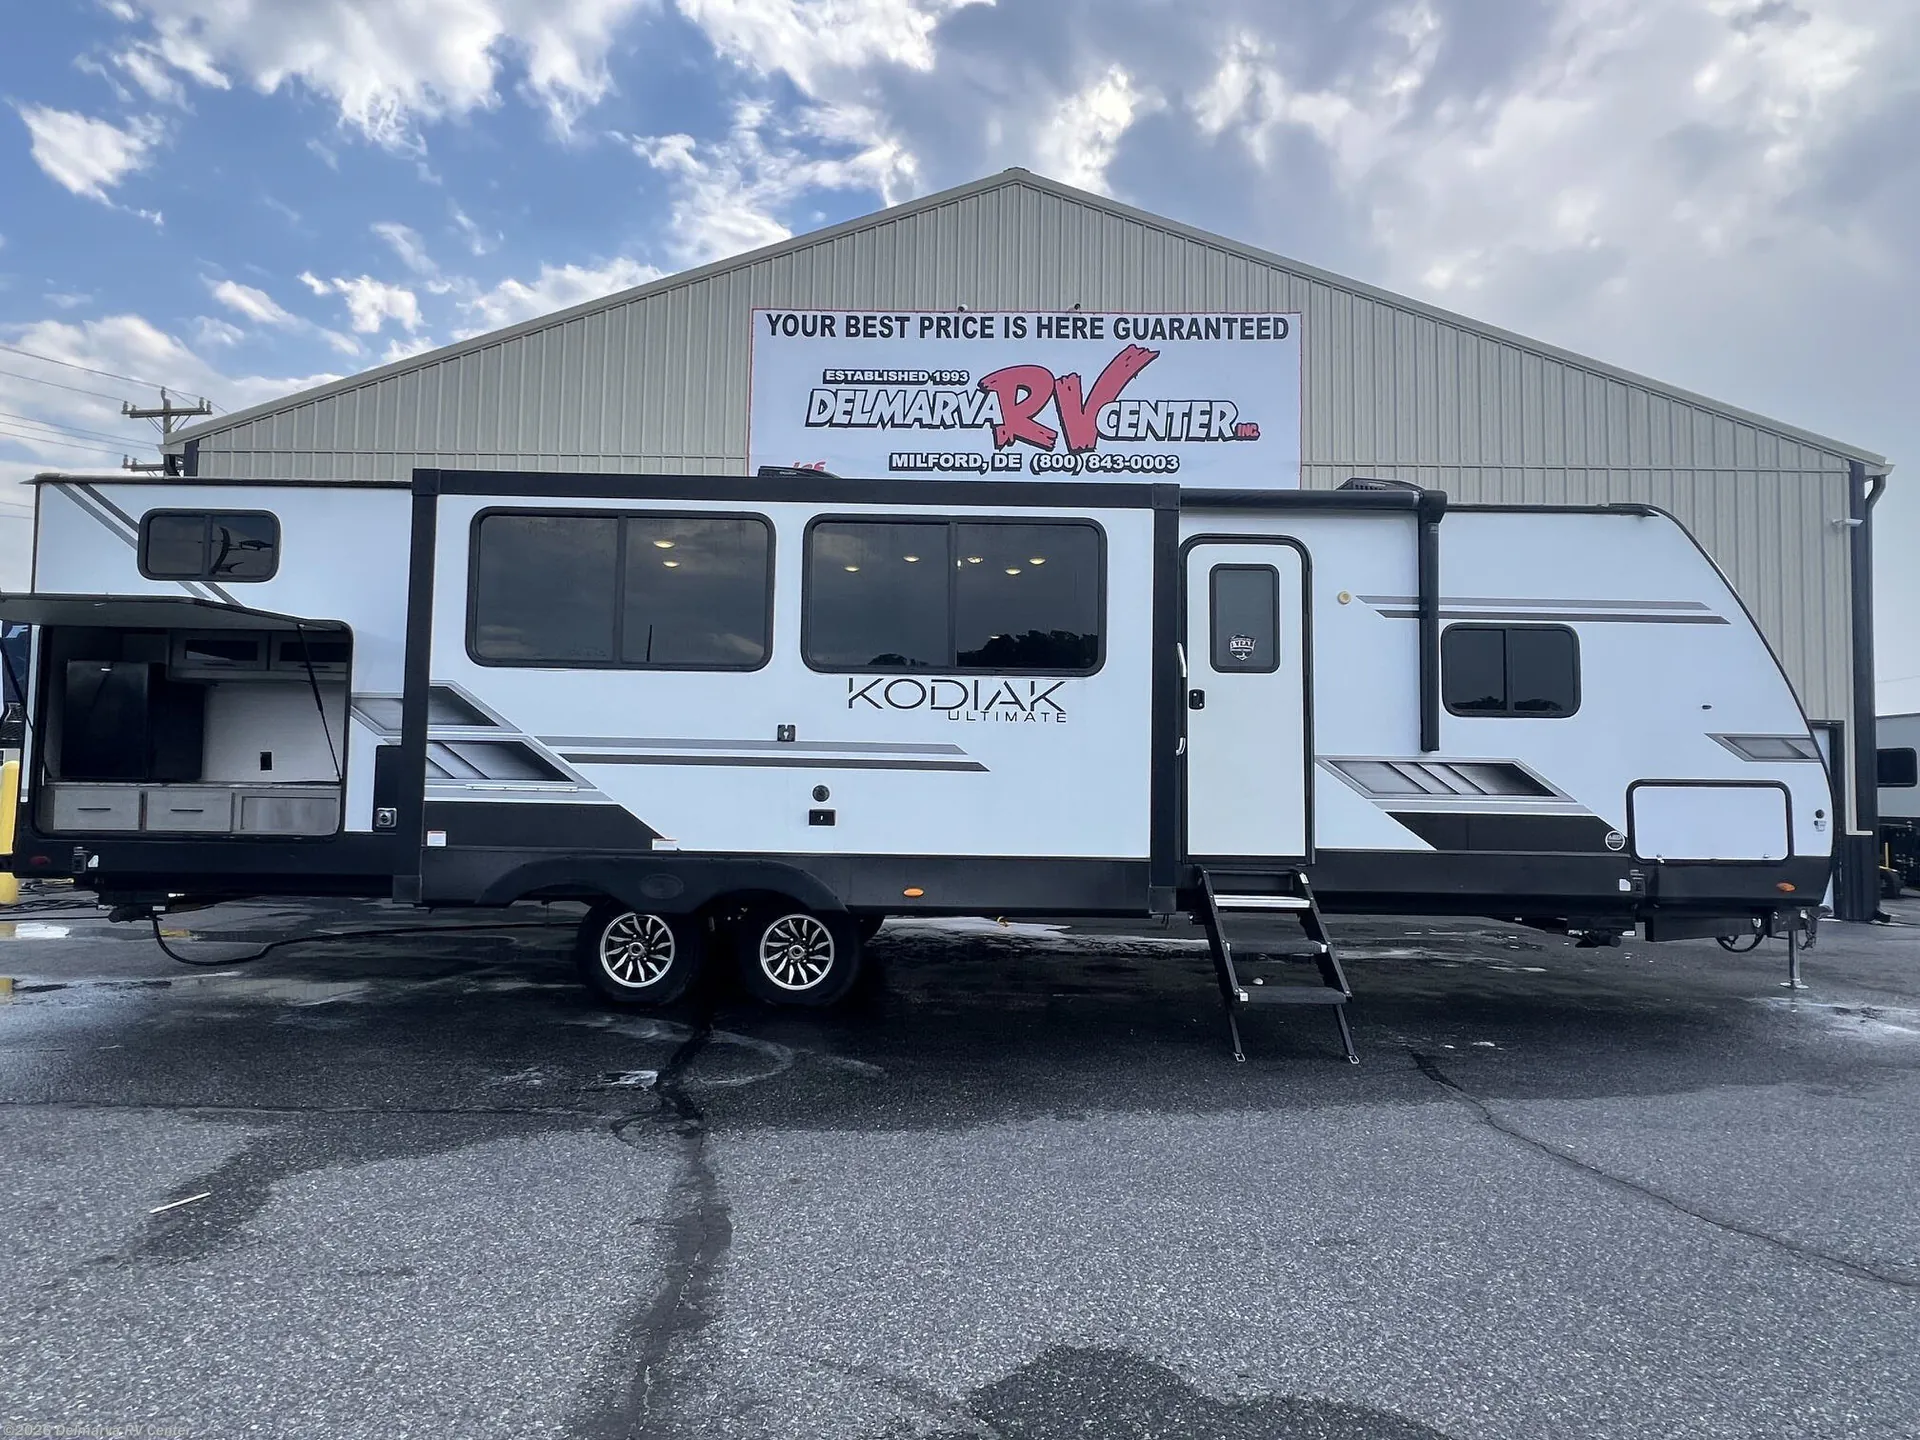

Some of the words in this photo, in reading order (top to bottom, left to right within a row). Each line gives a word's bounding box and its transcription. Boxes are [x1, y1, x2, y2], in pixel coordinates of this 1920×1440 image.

[766, 313, 836, 338] YOUR
[845, 315, 911, 339] BEST
[919, 316, 995, 339] PRICE
[1004, 316, 1028, 339] IS
[1036, 316, 1104, 340] HERE
[1113, 317, 1289, 341] GUARANTEED
[824, 369, 931, 384] ESTABLISHED
[932, 370, 970, 384] 1993
[806, 388, 1004, 428] DELMARVA
[978, 343, 1161, 454] RV
[1095, 400, 1239, 441] CENTER
[889, 452, 989, 474] MILFORD,
[991, 453, 1022, 471] DE
[1030, 454, 1084, 475] (800)
[1085, 454, 1180, 473] 843-0003
[848, 677, 1067, 713] KODIAK
[947, 711, 1067, 723] ULTIMATE
